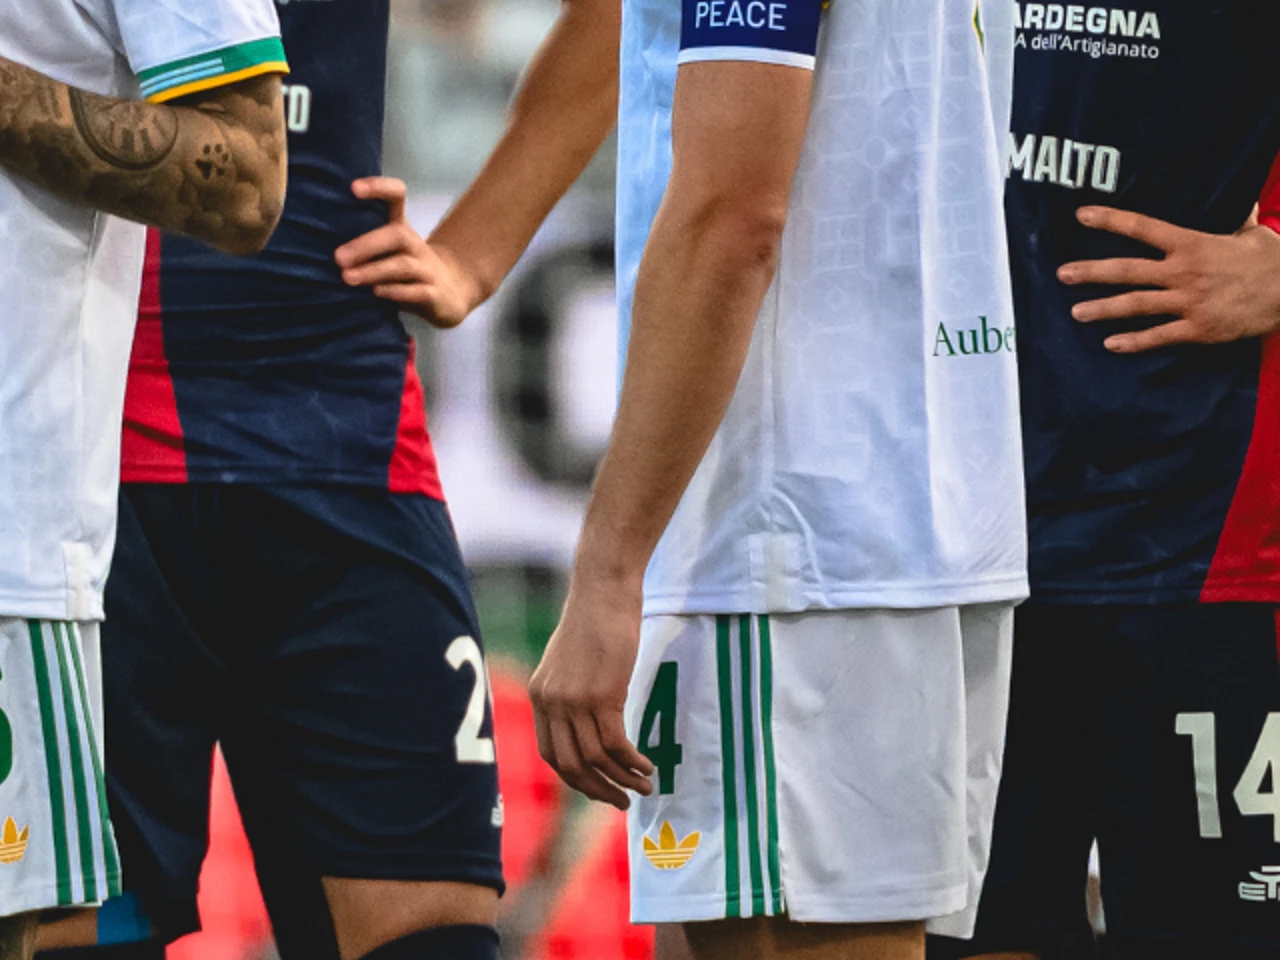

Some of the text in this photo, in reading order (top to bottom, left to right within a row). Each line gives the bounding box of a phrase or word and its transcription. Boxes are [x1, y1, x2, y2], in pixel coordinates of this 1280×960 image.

[695, 0, 787, 31] PEACE
[1007, 132, 1121, 193] MALTO
[932, 315, 1016, 356] Aube
[444, 635, 495, 763] 2
[638, 661, 682, 795] 4
[1175, 711, 1280, 843] 14
